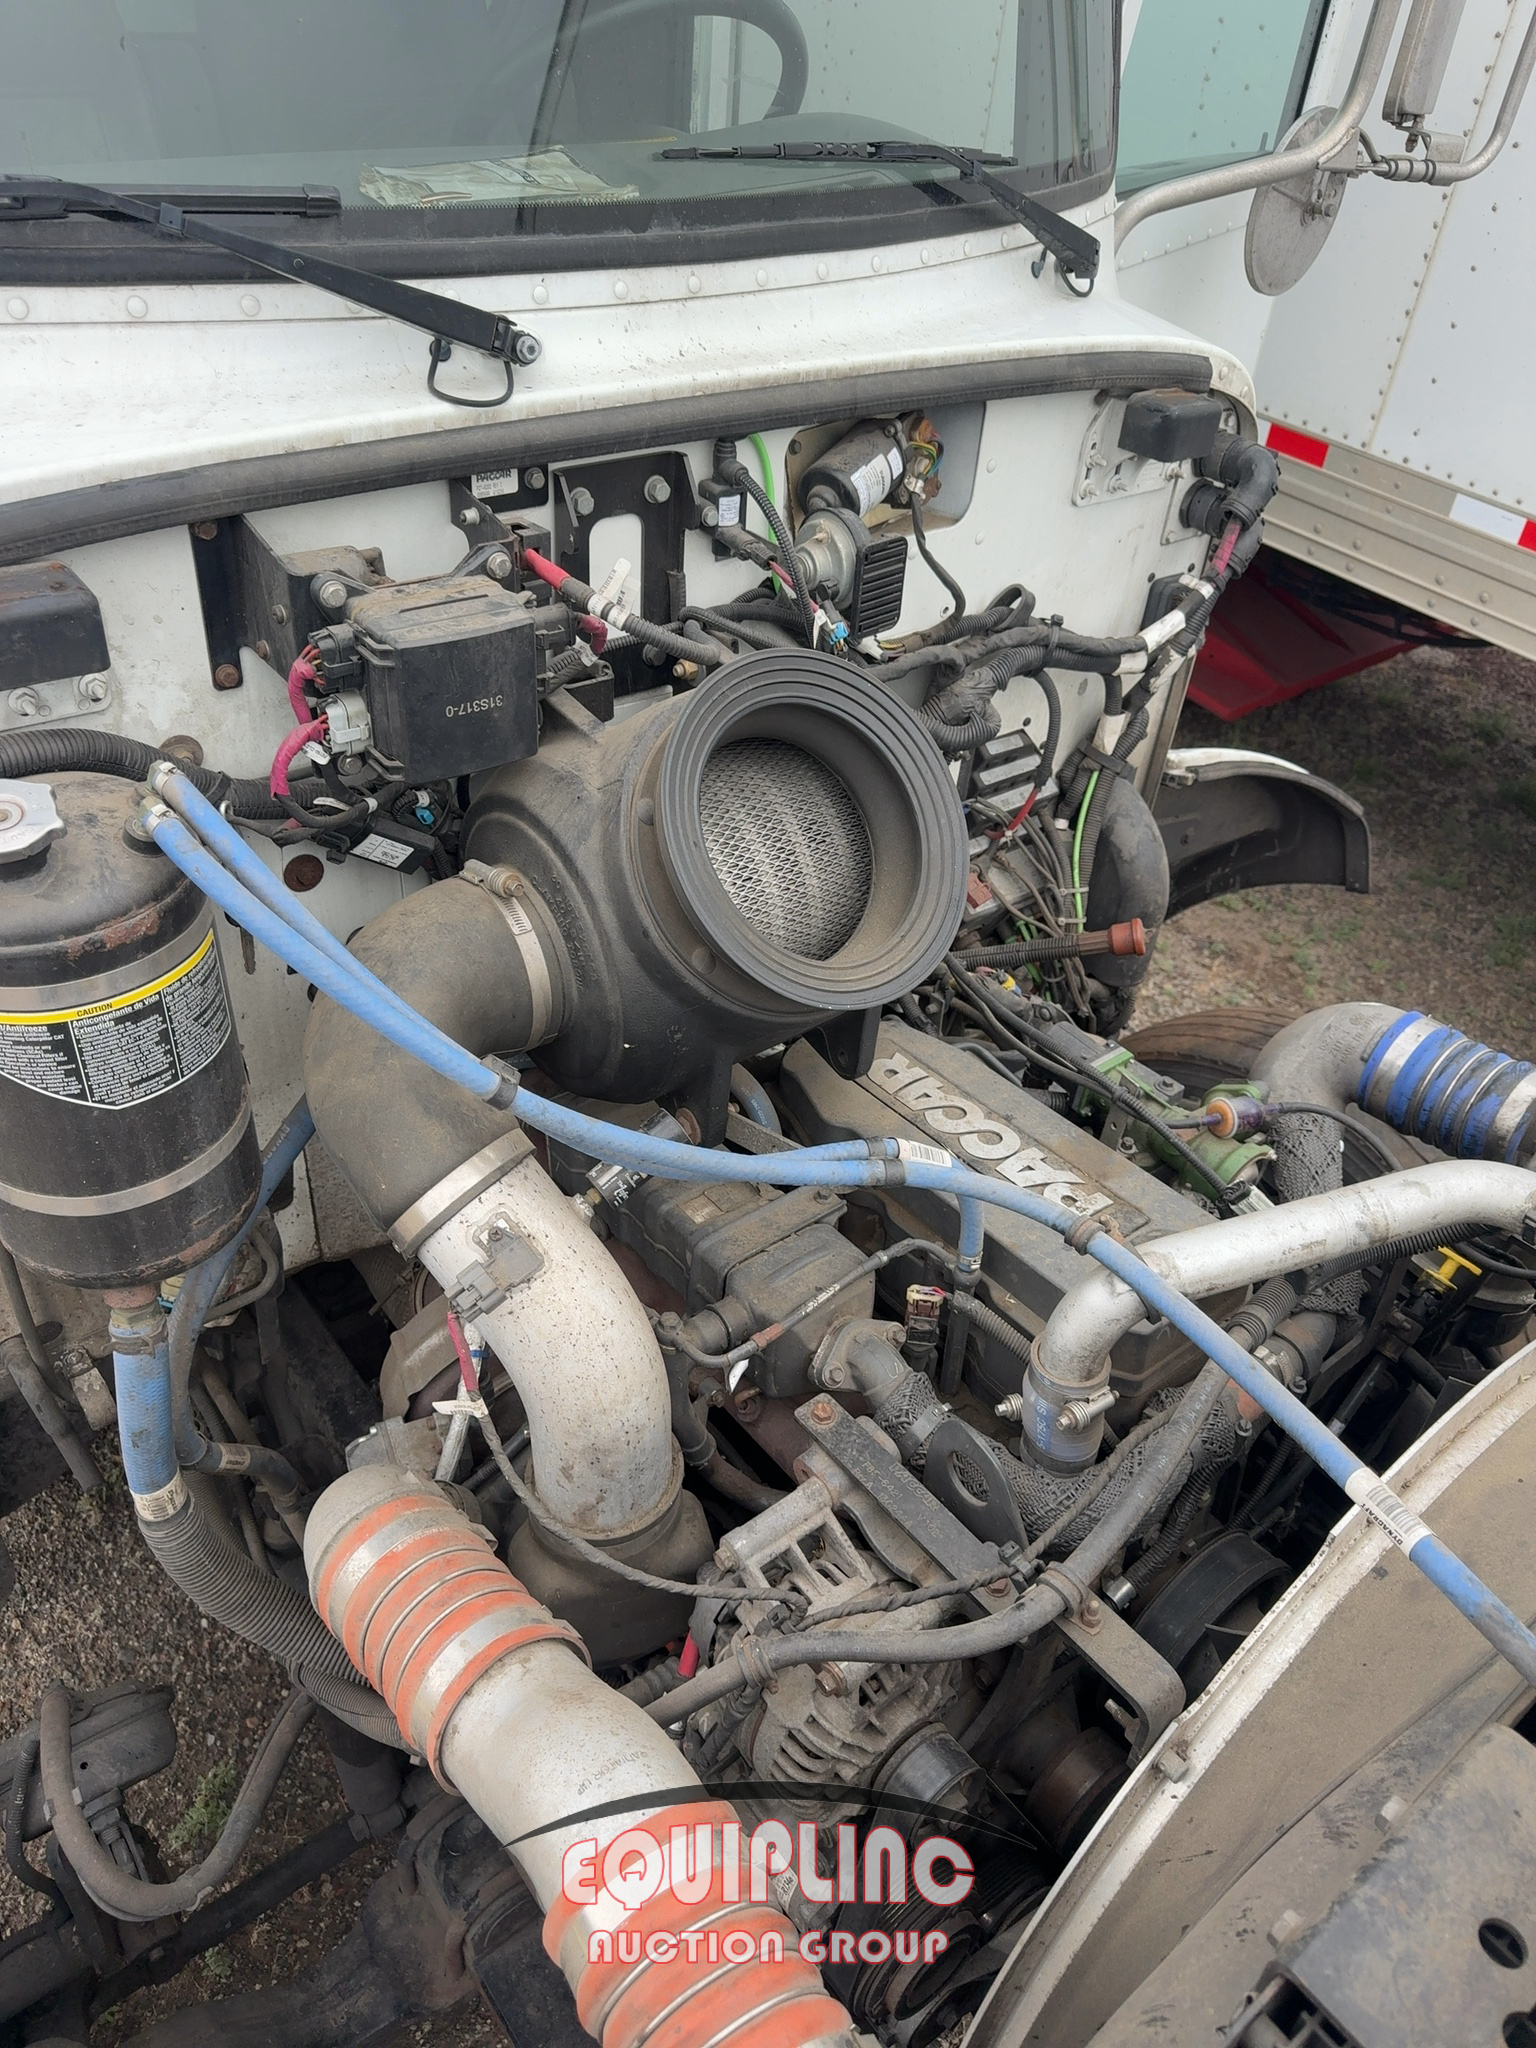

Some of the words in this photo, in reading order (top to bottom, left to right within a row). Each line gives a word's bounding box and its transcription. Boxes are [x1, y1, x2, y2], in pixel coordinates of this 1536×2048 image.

[476, 470, 512, 482] PACCAR
[445, 694, 503, 718] 31S317-0
[73, 1004, 133, 1028] Anticongelante
[144, 994, 160, 1005] Vida
[77, 1002, 113, 1017] CAUTION
[74, 1020, 115, 1036] Extendida
[867, 1051, 1114, 1217] PACCAR
[888, 1462, 942, 1512] PACCAR
[1360, 1503, 1403, 1546] DYNACRAFT
